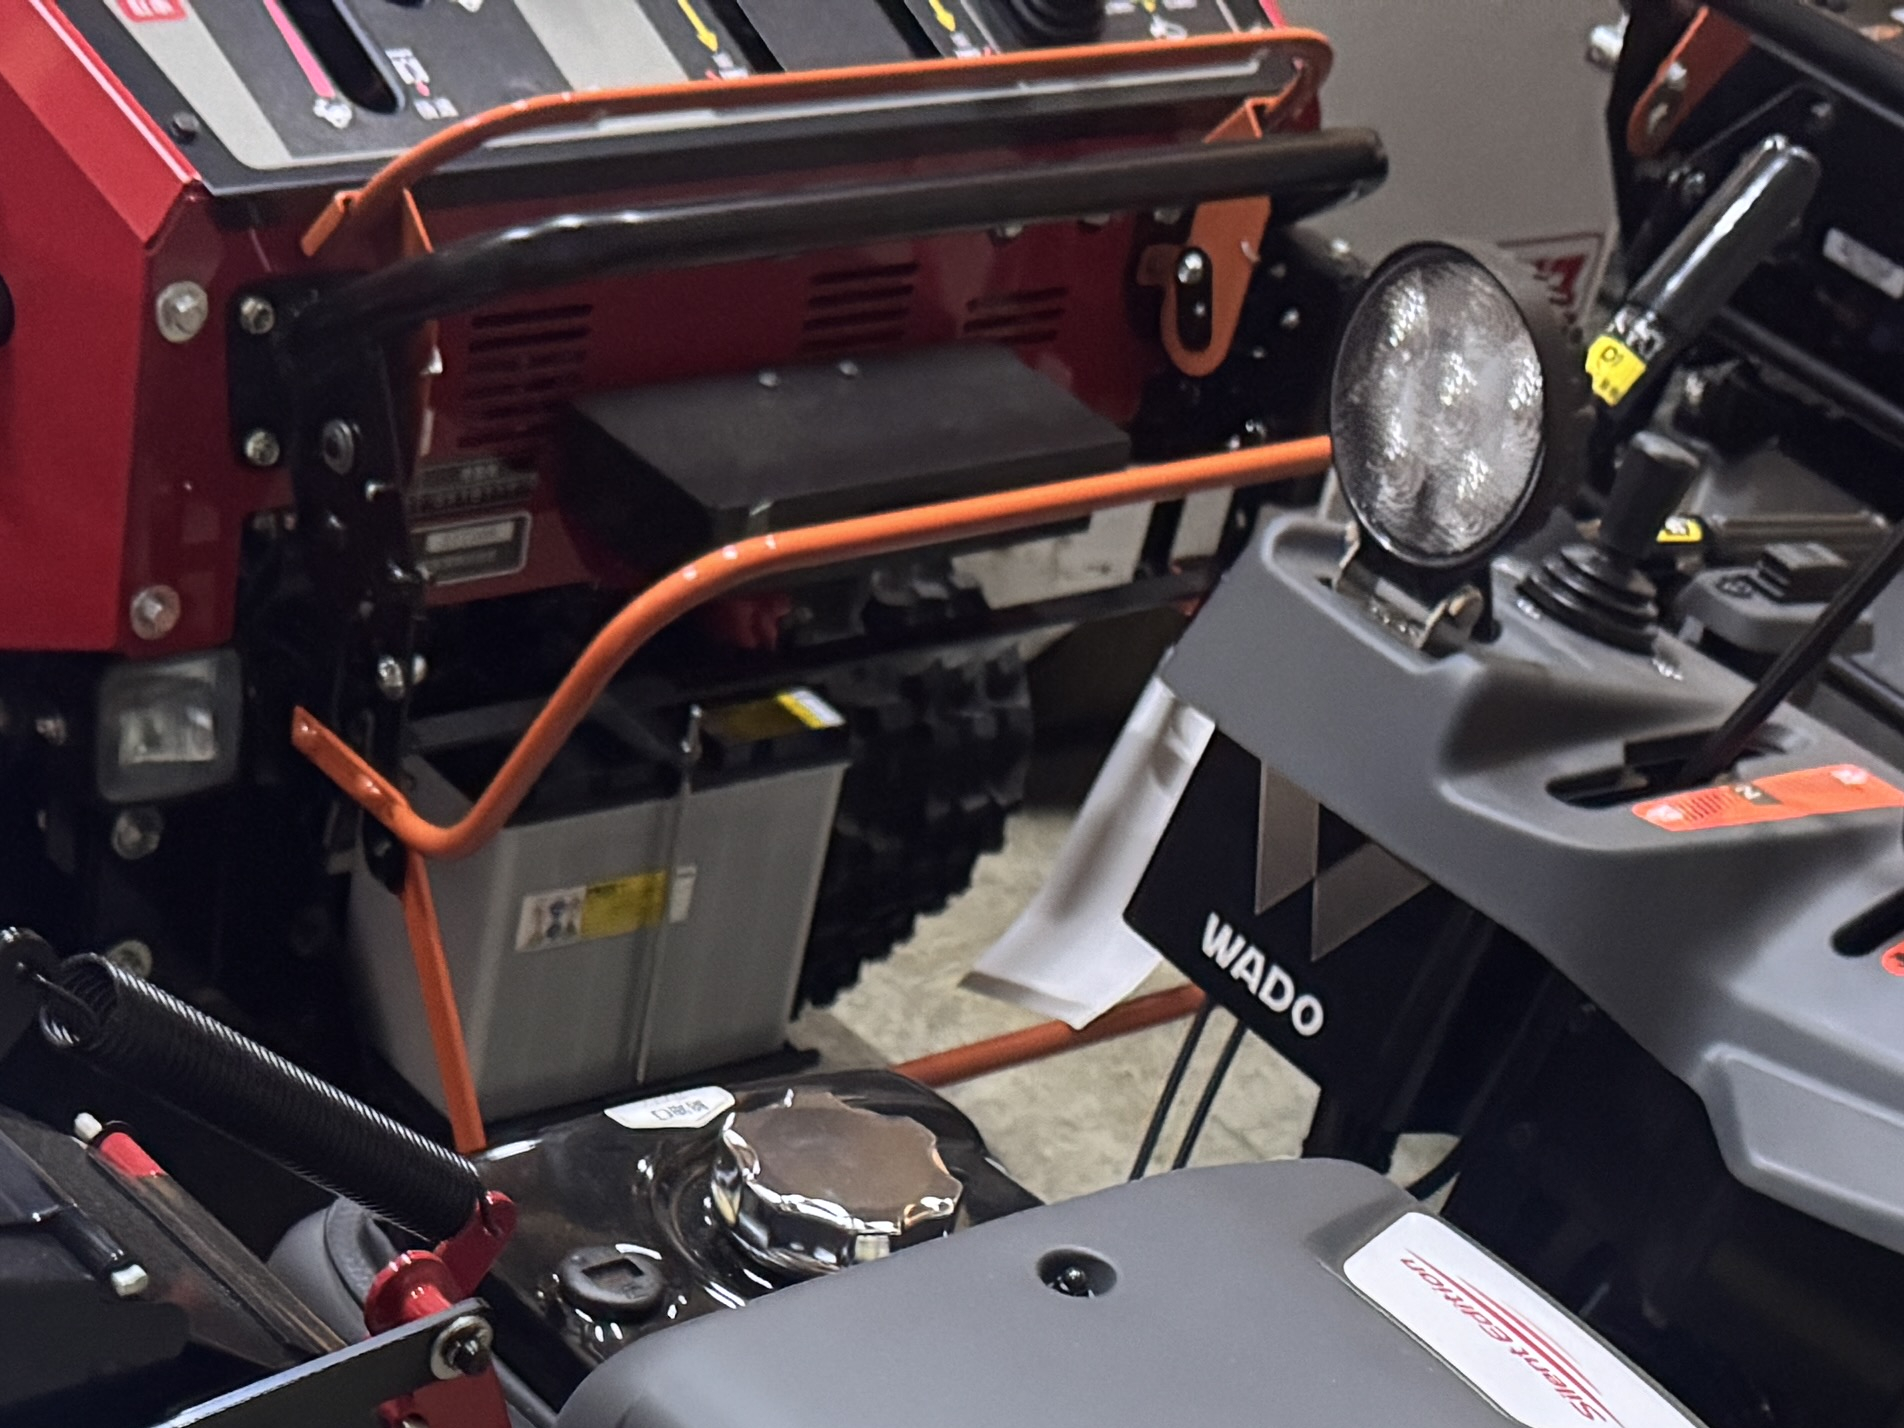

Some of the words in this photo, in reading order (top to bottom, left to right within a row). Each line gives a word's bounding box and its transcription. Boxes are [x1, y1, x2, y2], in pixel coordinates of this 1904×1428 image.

[1201, 910, 1325, 1038] WADO
[1399, 1257, 1514, 1344] Edition
[1510, 1345, 1608, 1423] Silent
